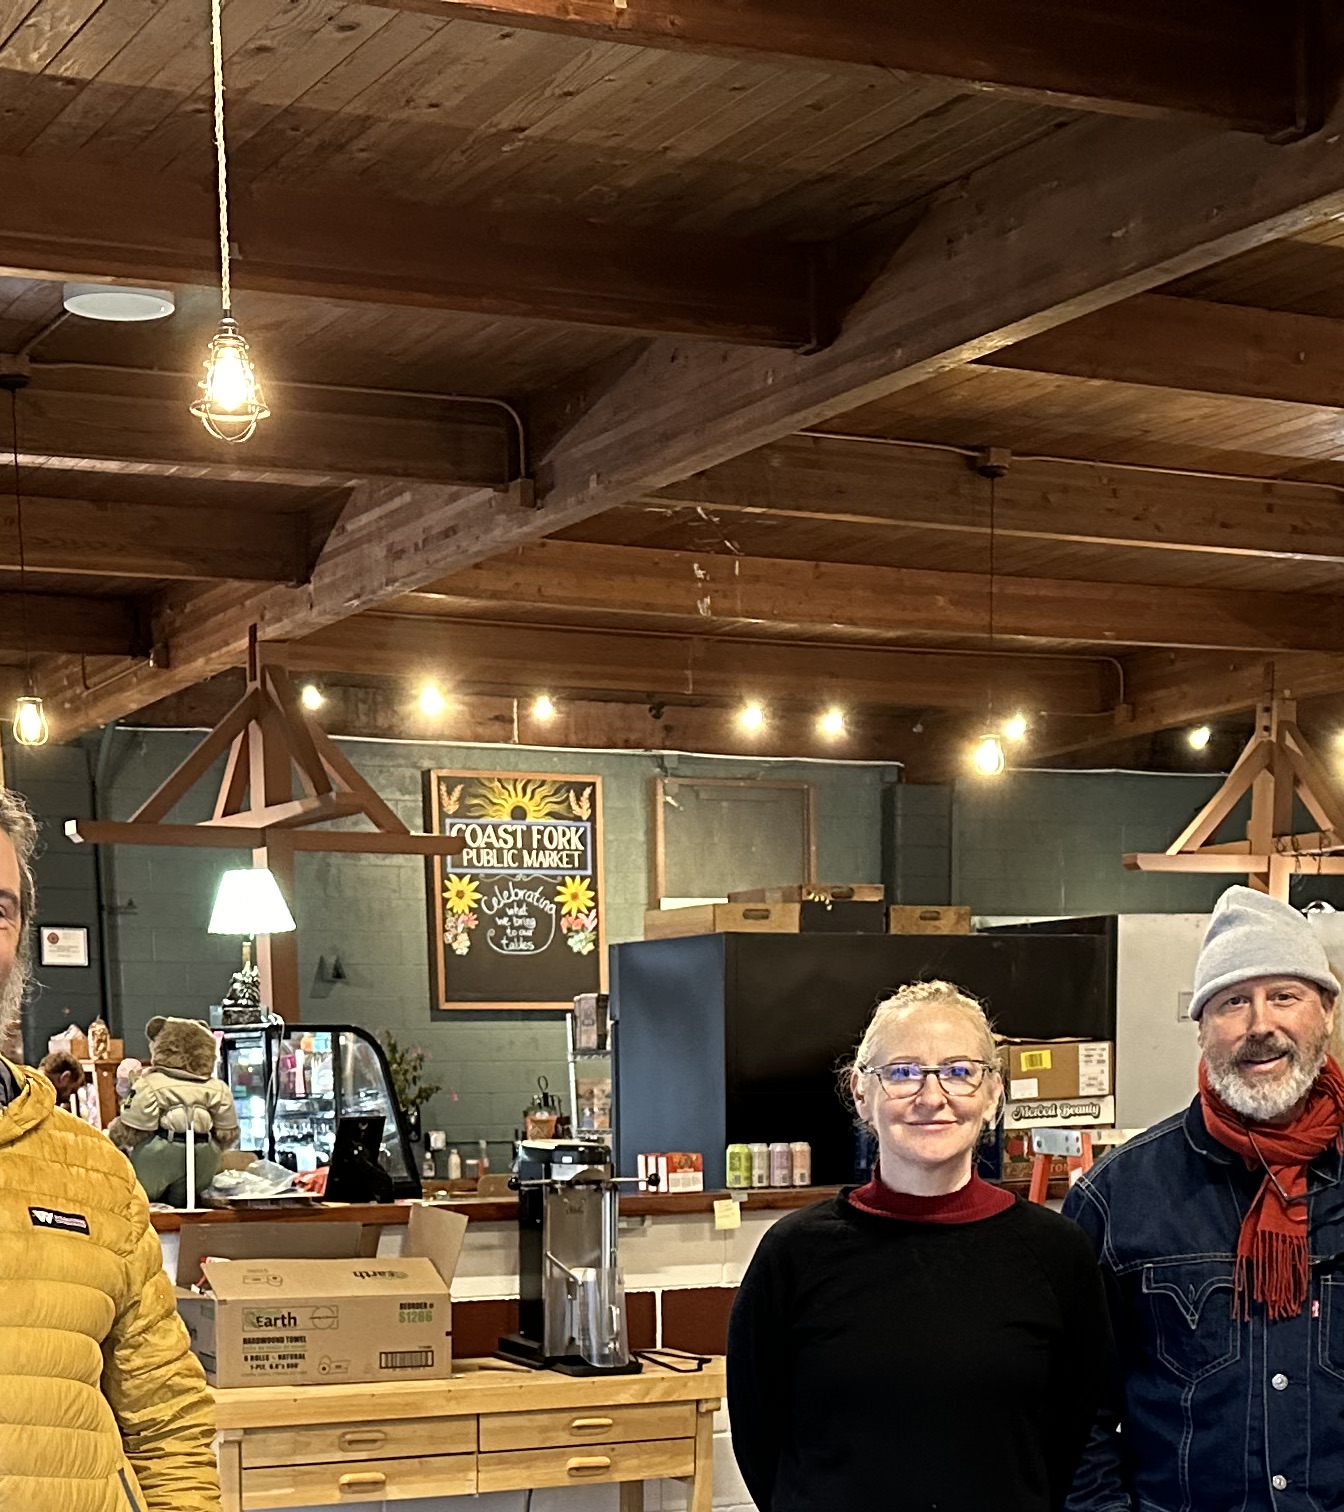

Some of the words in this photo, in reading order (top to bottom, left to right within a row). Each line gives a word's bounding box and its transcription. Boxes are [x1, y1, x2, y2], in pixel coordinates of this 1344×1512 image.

[451, 824, 526, 848] COAST
[532, 826, 585, 850] FORK
[462, 849, 519, 867] PUBLIC
[523, 850, 582, 868] MARKET
[481, 881, 556, 914] Celebrating
[506, 902, 528, 916] what
[496, 917, 511, 926] we
[513, 916, 537, 928] bring
[506, 928, 517, 938] to
[519, 929, 534, 937] our
[501, 938, 535, 950] tables
[1012, 1103, 1058, 1121] Merced
[1059, 1102, 1101, 1119] Beauty
[256, 1311, 297, 1328] Earth
